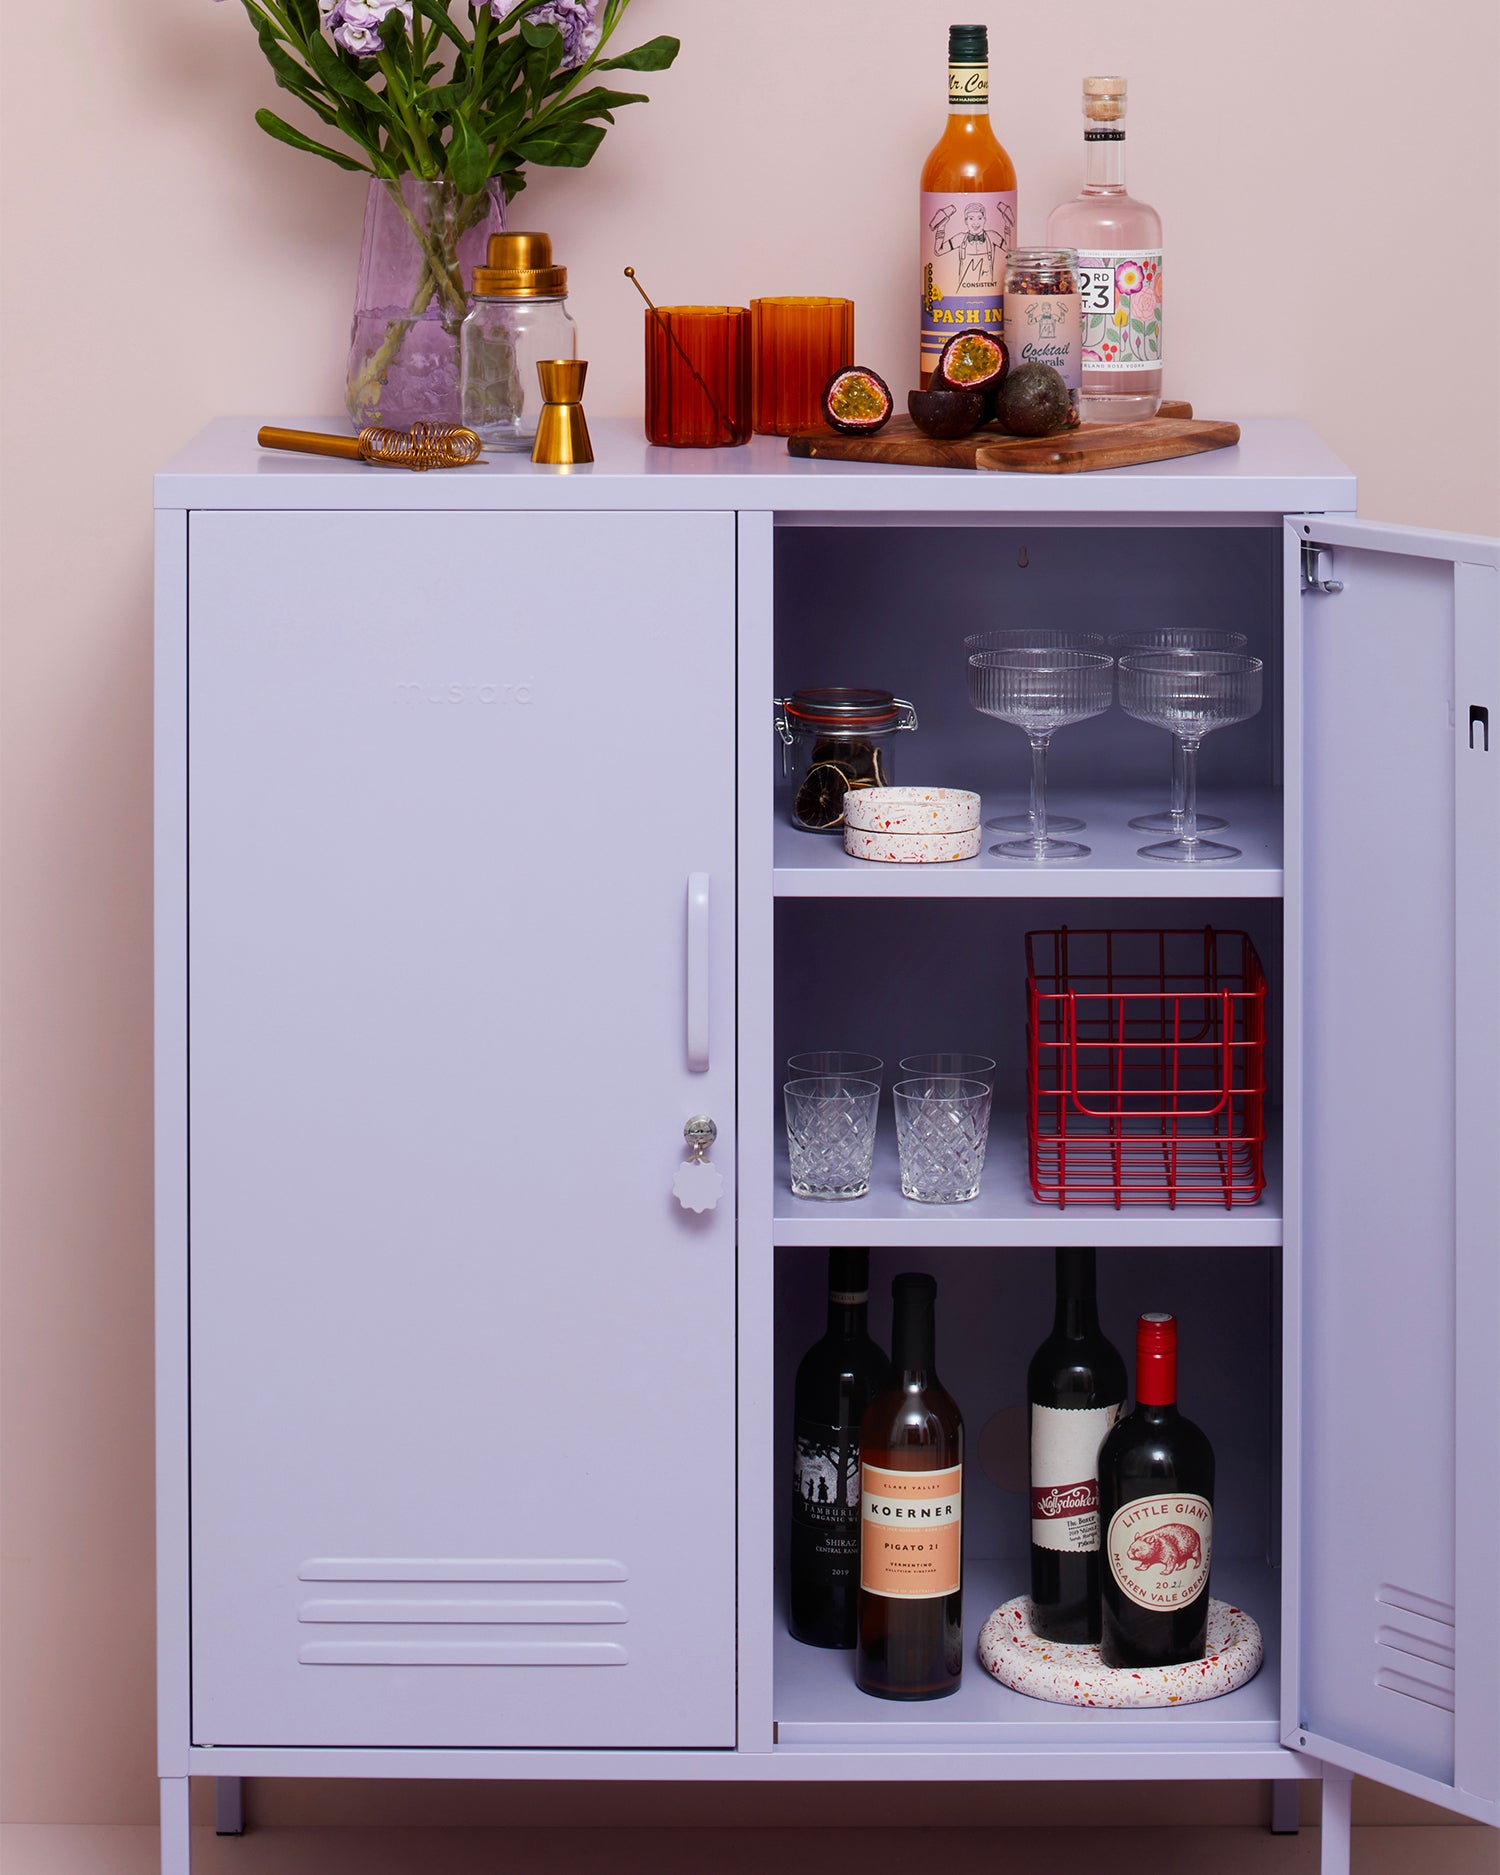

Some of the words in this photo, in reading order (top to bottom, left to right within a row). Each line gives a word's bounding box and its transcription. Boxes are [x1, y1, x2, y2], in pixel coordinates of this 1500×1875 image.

[956, 258, 989, 294] Mr
[1093, 273, 1110, 282] RD
[932, 308, 980, 324] PASH
[1021, 342, 1071, 359] Cocktail
[394, 675, 535, 705] mustard
[1037, 1486, 1097, 1517] Mollydooker
[803, 1502, 859, 1517] TAMBURL
[871, 1503, 952, 1518] KOERNER
[1122, 1504, 1169, 1528] LITTLE
[1175, 1503, 1208, 1522] GIANT
[811, 1513, 845, 1523] ORGANIC
[816, 1546, 842, 1554] CENTRAL
[825, 1539, 857, 1547] SHIRAZ
[884, 1543, 924, 1551] PIGATO
[1113, 1553, 1147, 1598] McLAREN
[1151, 1594, 1178, 1602] VALE
